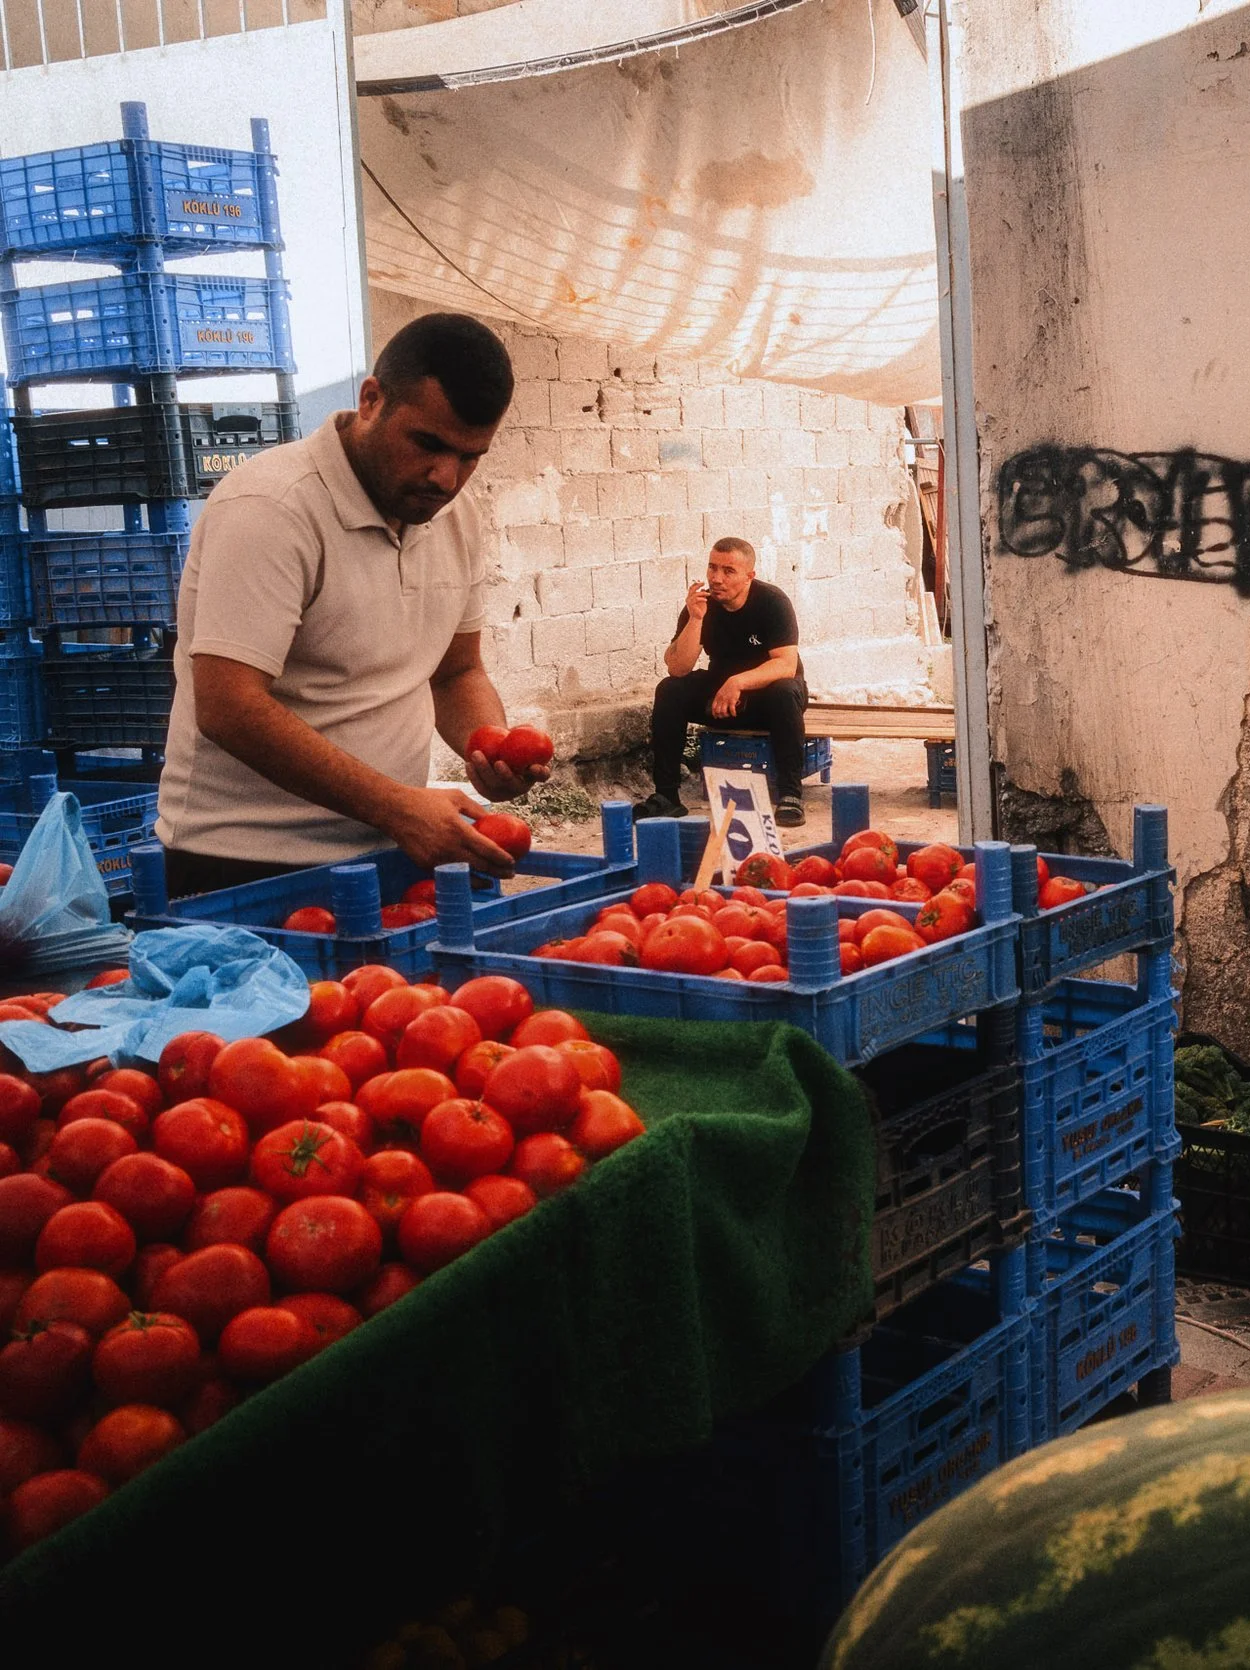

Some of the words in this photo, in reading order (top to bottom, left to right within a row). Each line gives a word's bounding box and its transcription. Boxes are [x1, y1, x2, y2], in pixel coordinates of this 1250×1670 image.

[223, 204, 242, 217] 196
[197, 328, 233, 343] KÖKLÜ
[237, 331, 255, 344] 196
